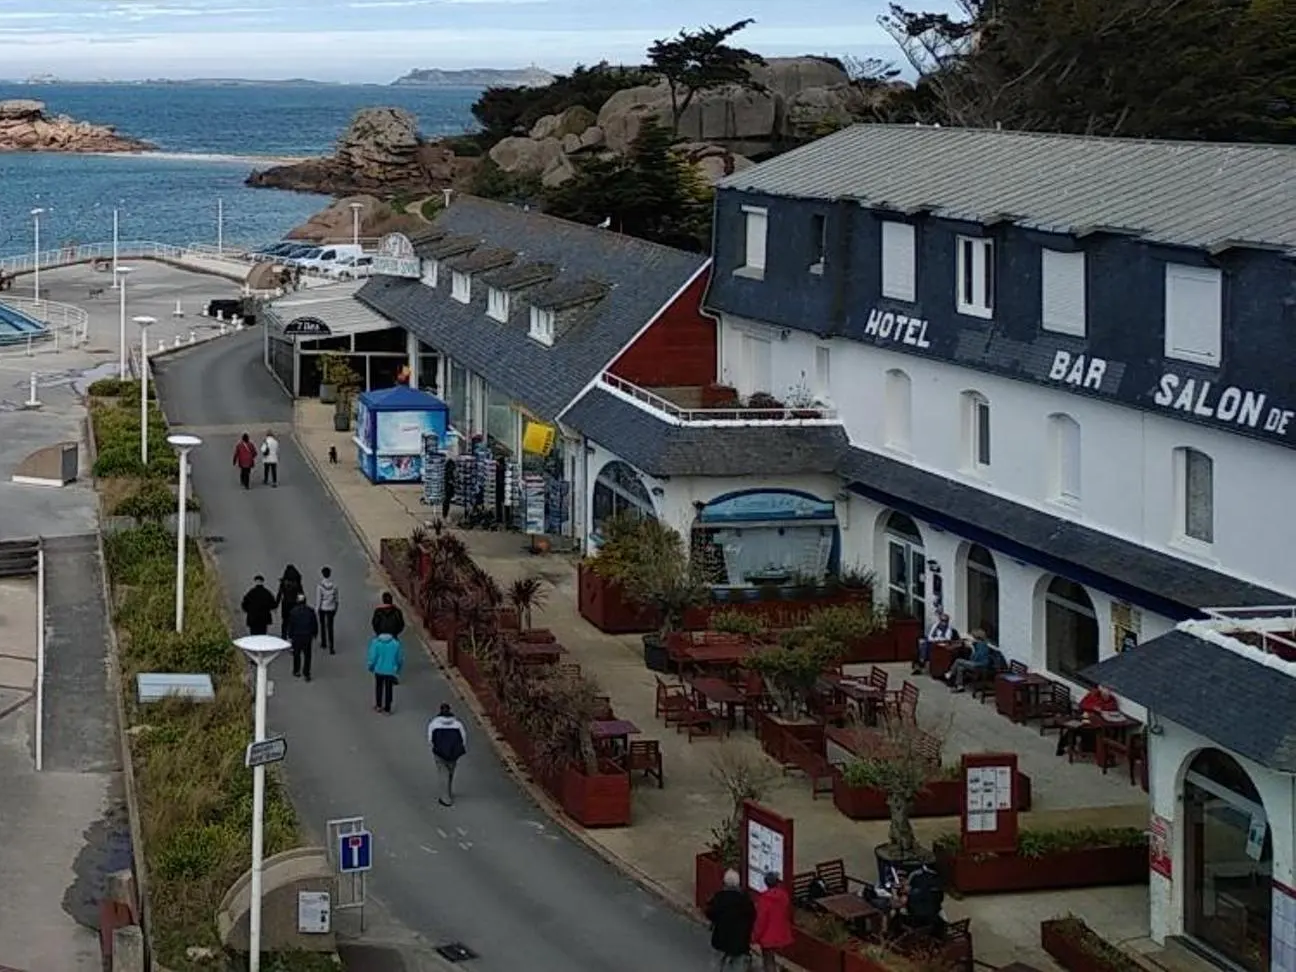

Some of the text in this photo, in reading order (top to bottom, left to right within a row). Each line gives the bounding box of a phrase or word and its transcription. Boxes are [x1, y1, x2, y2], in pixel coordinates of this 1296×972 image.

[865, 308, 1294, 435] HOTEL BAR SALON DE
